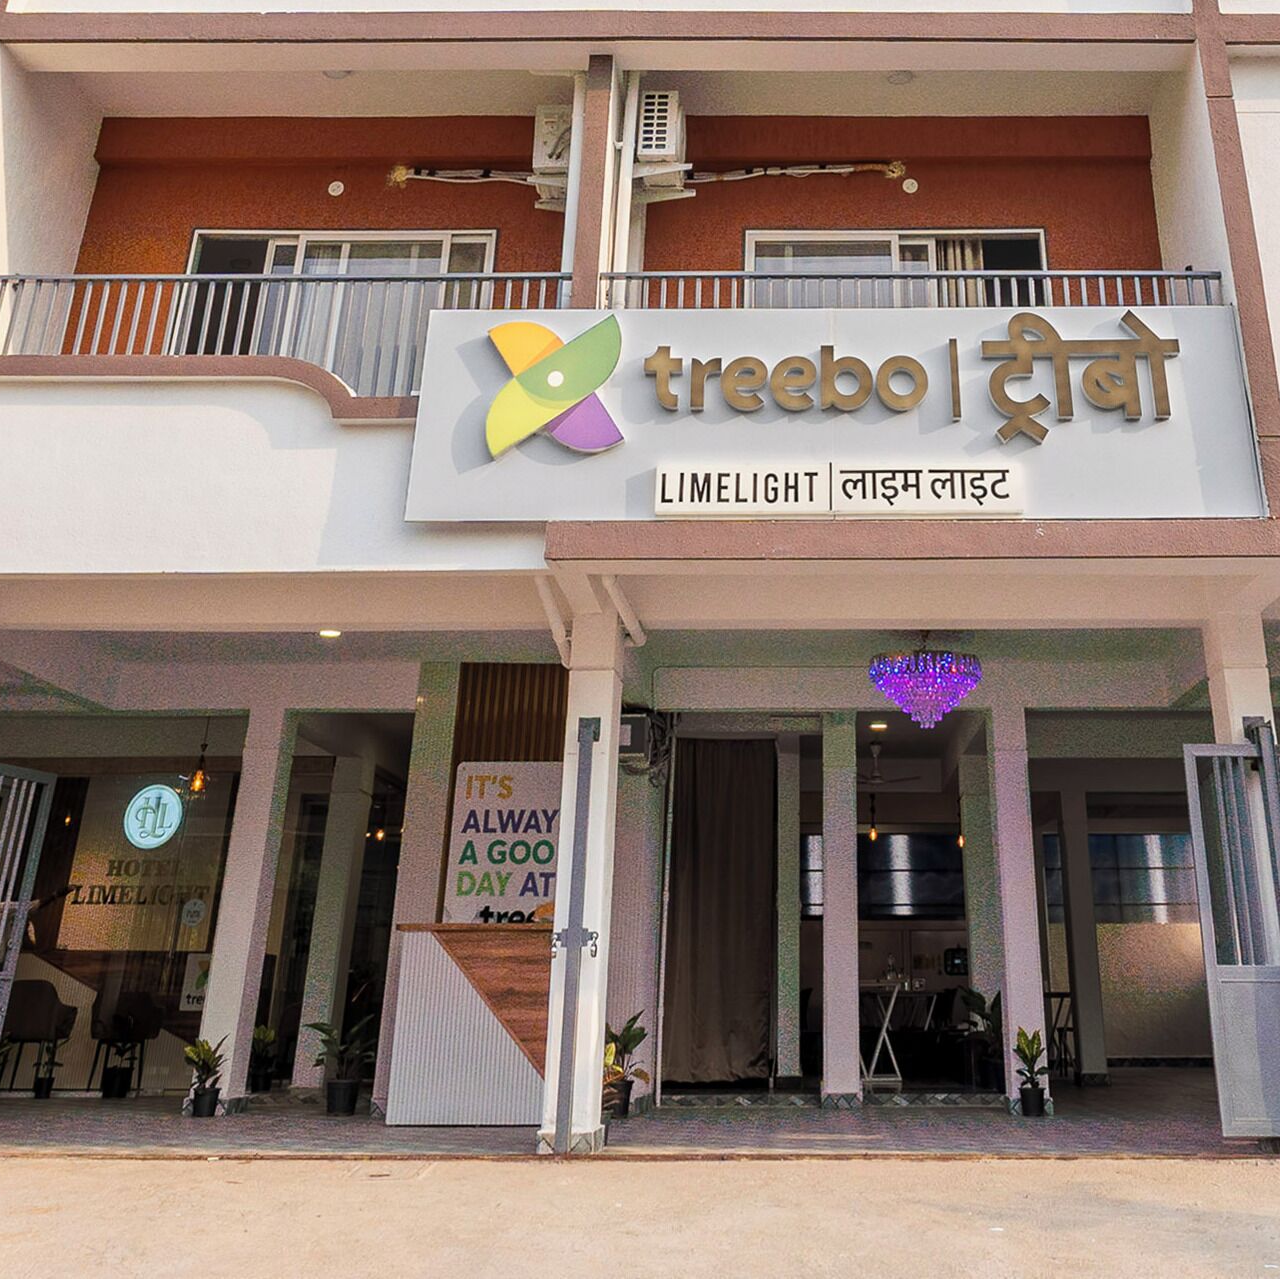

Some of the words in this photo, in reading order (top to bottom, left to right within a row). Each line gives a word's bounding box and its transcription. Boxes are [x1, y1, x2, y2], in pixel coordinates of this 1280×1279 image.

[643, 345, 930, 413] treebo
[980, 310, 1181, 444] ट्रीबो
[659, 471, 819, 503] LIMELIGHT
[839, 468, 923, 502] लाइम
[928, 467, 1013, 501] लाइट
[465, 775, 513, 799] IT'S
[461, 809, 560, 834] ALWAY
[458, 841, 478, 865] A
[487, 840, 555, 865] GOO
[106, 859, 185, 877] HOTEL
[69, 884, 210, 905] LIMELIGHT
[456, 872, 511, 897] DAY
[519, 872, 556, 897] AT
[479, 906, 536, 923] tre
[186, 993, 205, 1005] tre
